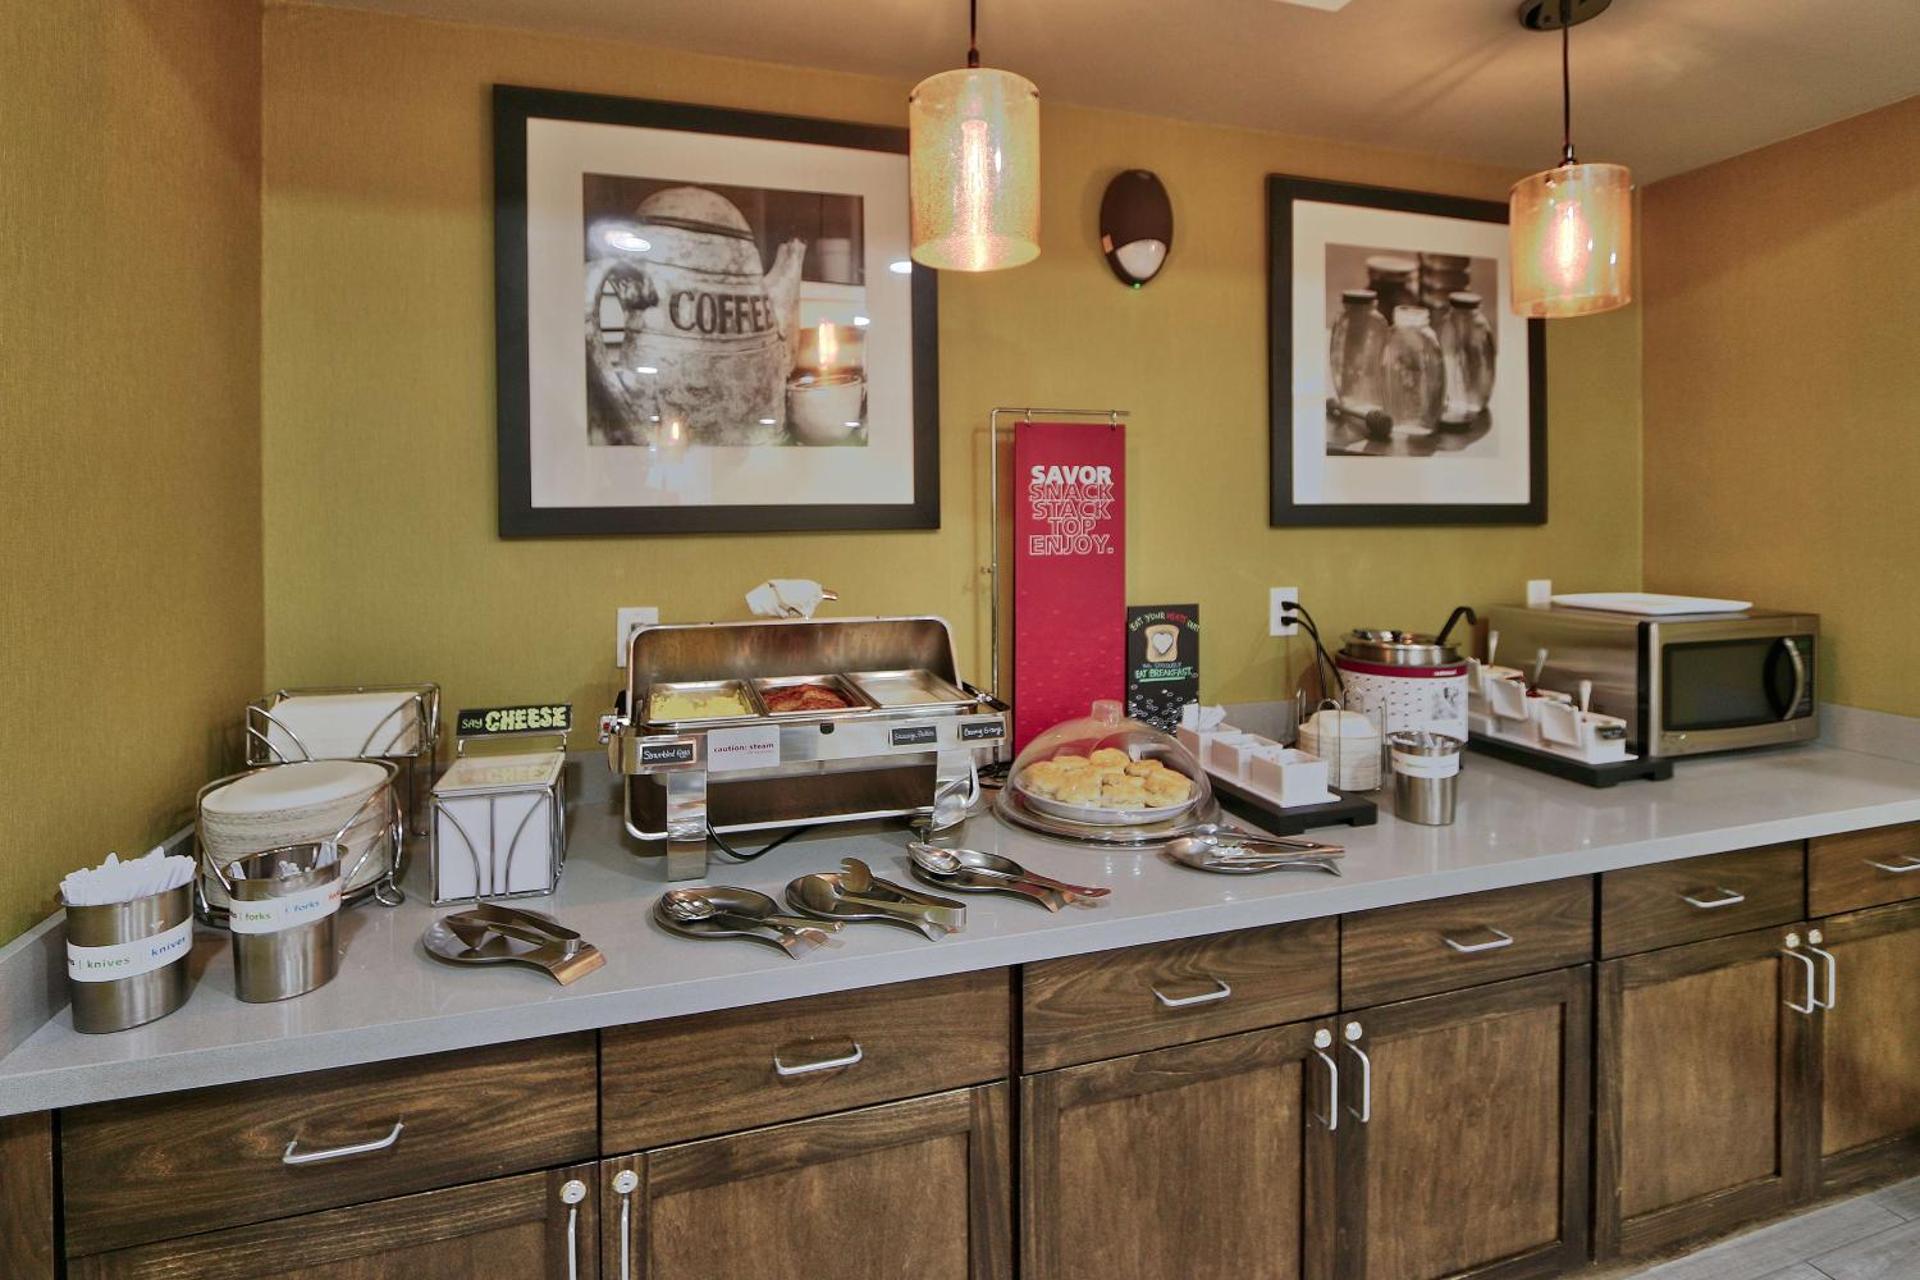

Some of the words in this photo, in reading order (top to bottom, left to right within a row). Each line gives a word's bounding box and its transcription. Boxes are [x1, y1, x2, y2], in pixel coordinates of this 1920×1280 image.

[669, 291, 774, 334] COFFEE
[1031, 465, 1112, 485] SAVOR
[1028, 481, 1115, 502] SNACK
[1032, 499, 1112, 520] STACK
[1047, 516, 1097, 536] TOP
[1029, 533, 1114, 556] ENJOY.
[1144, 611, 1165, 622] YOUR
[1135, 669, 1148, 679] EAT
[485, 706, 567, 731] CHEESE
[713, 744, 747, 753] caution:
[245, 911, 271, 920] forks
[294, 901, 320, 912] forks
[86, 956, 130, 969] knives
